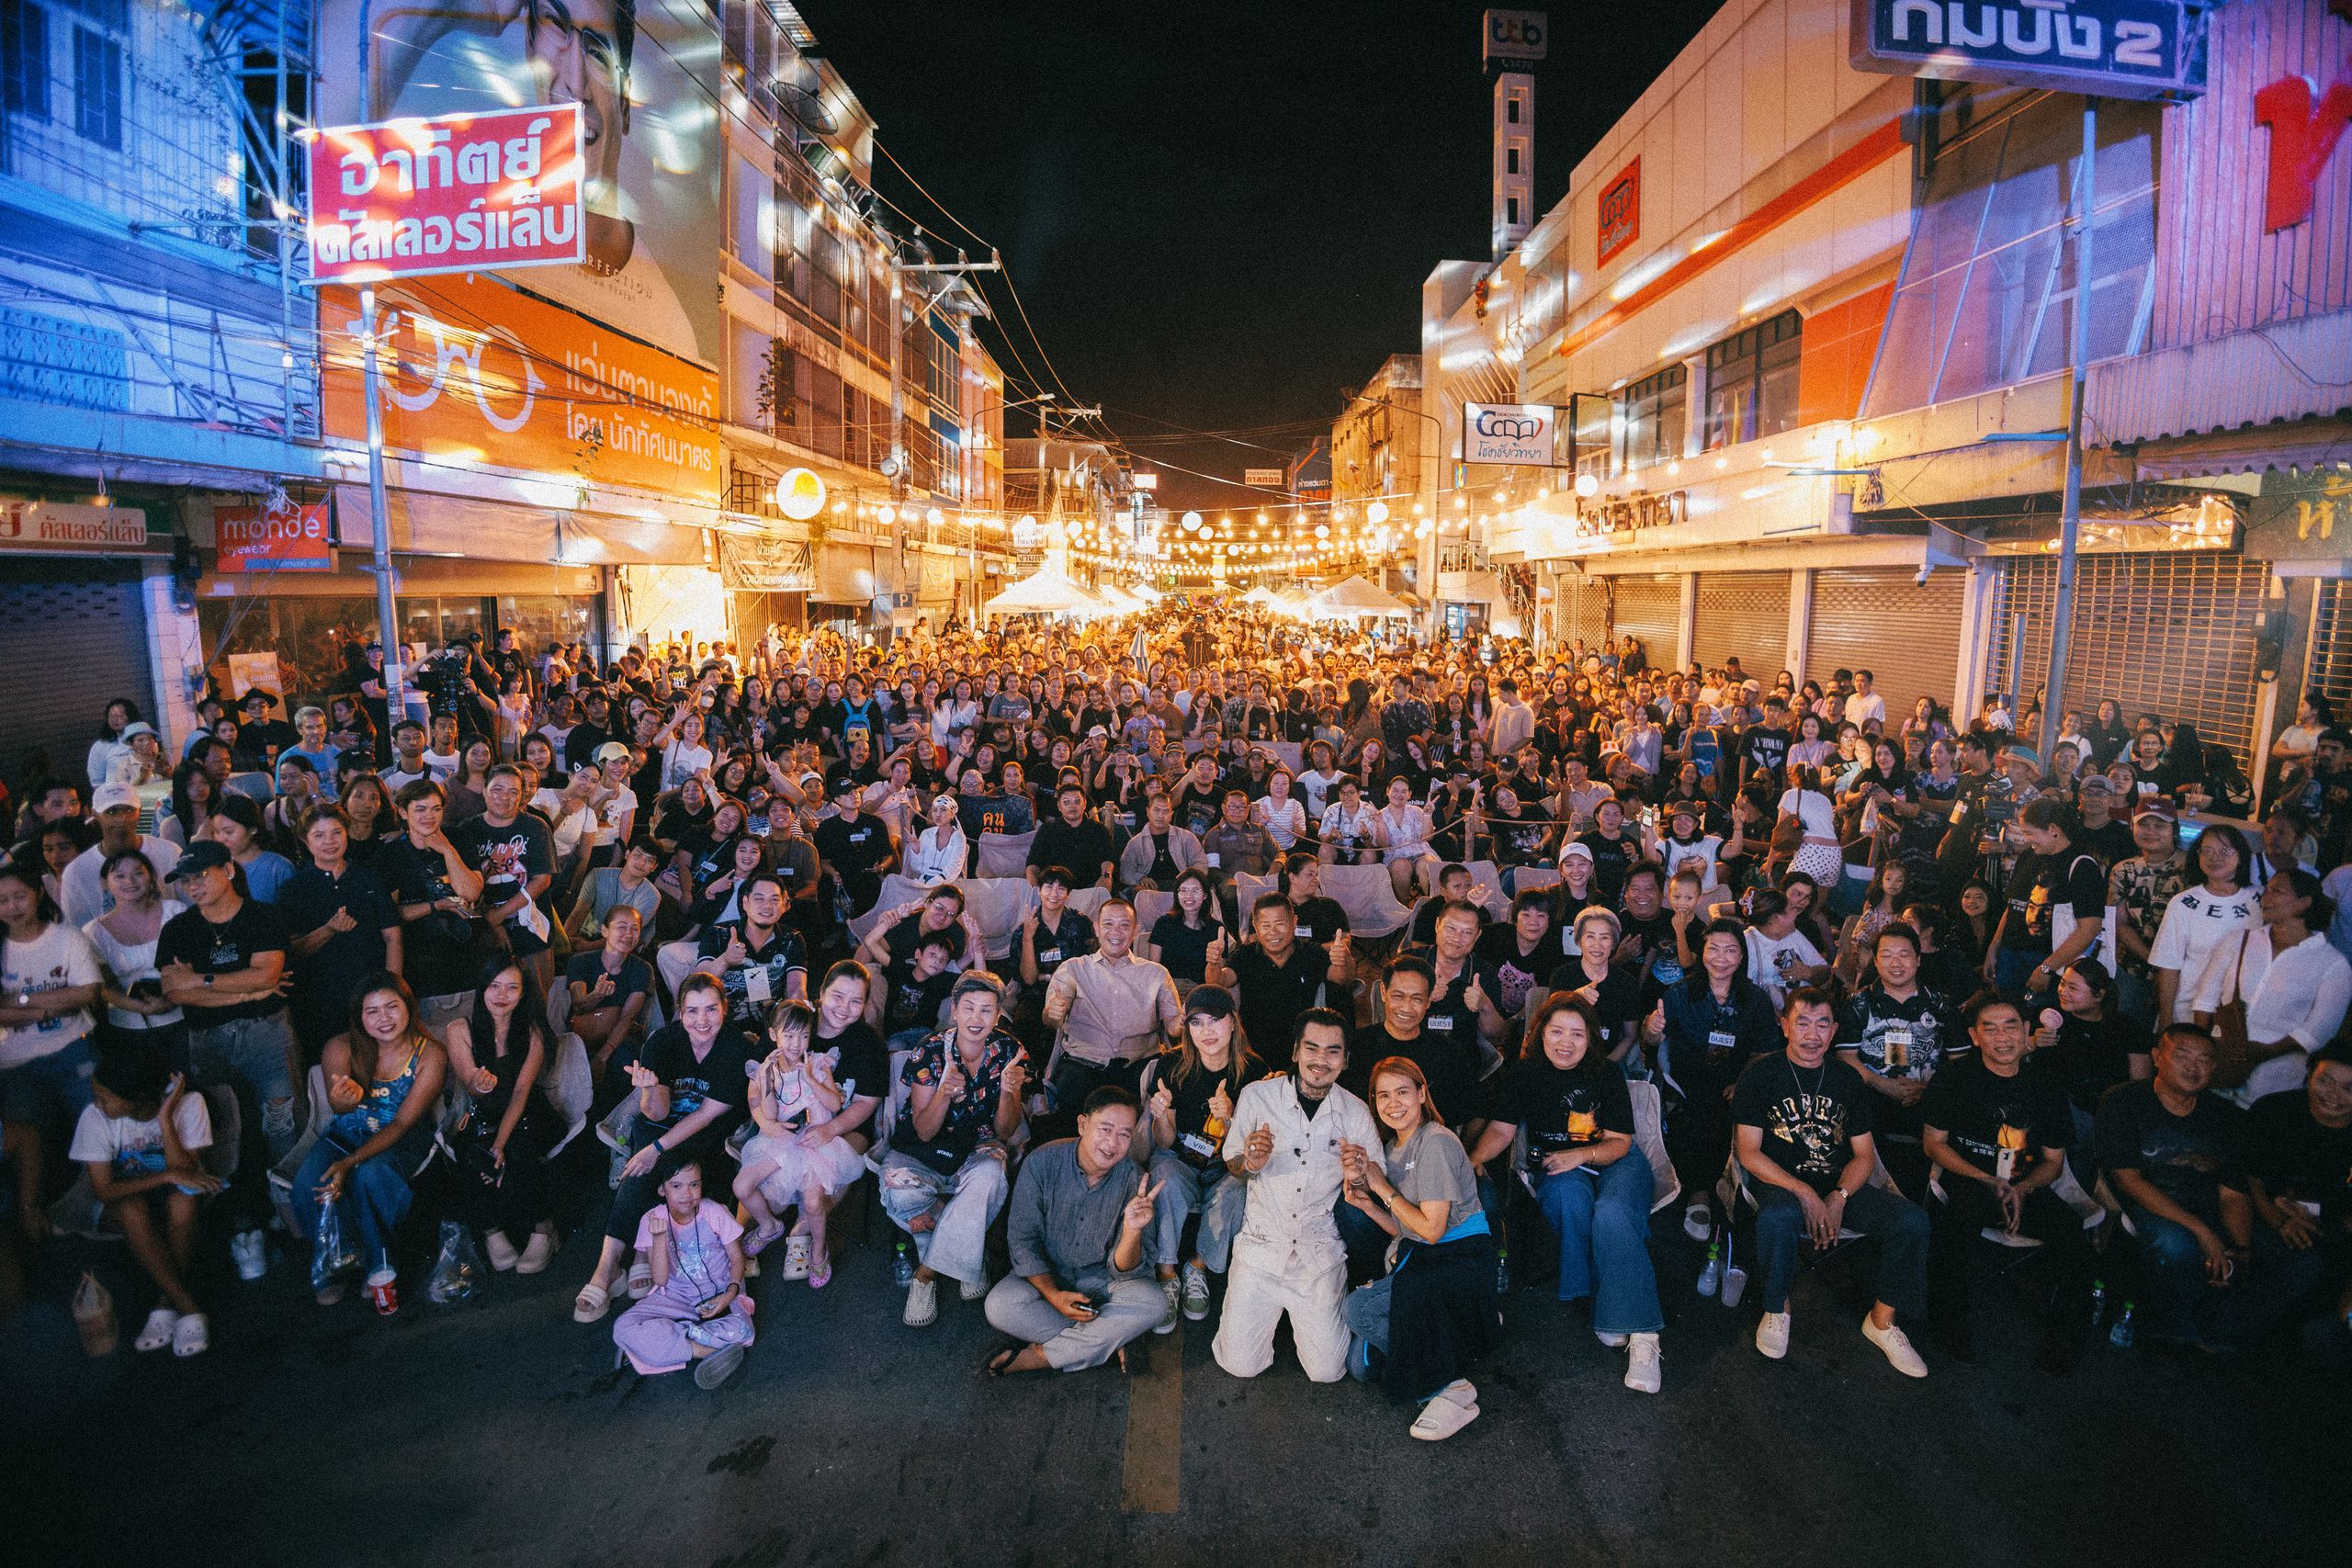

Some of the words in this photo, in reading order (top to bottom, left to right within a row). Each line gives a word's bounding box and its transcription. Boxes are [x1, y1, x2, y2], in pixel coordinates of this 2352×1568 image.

[2115, 18, 2161, 66] 2
[340, 118, 551, 196] อาทิตย์
[610, 412, 711, 471] นักทัศนมาตร
[223, 512, 321, 538] monde
[900, 594, 909, 607] P
[982, 812, 1005, 827] คน
[1711, 1035, 1734, 1045] GUEST
[1193, 1141, 1206, 1153] VIP
